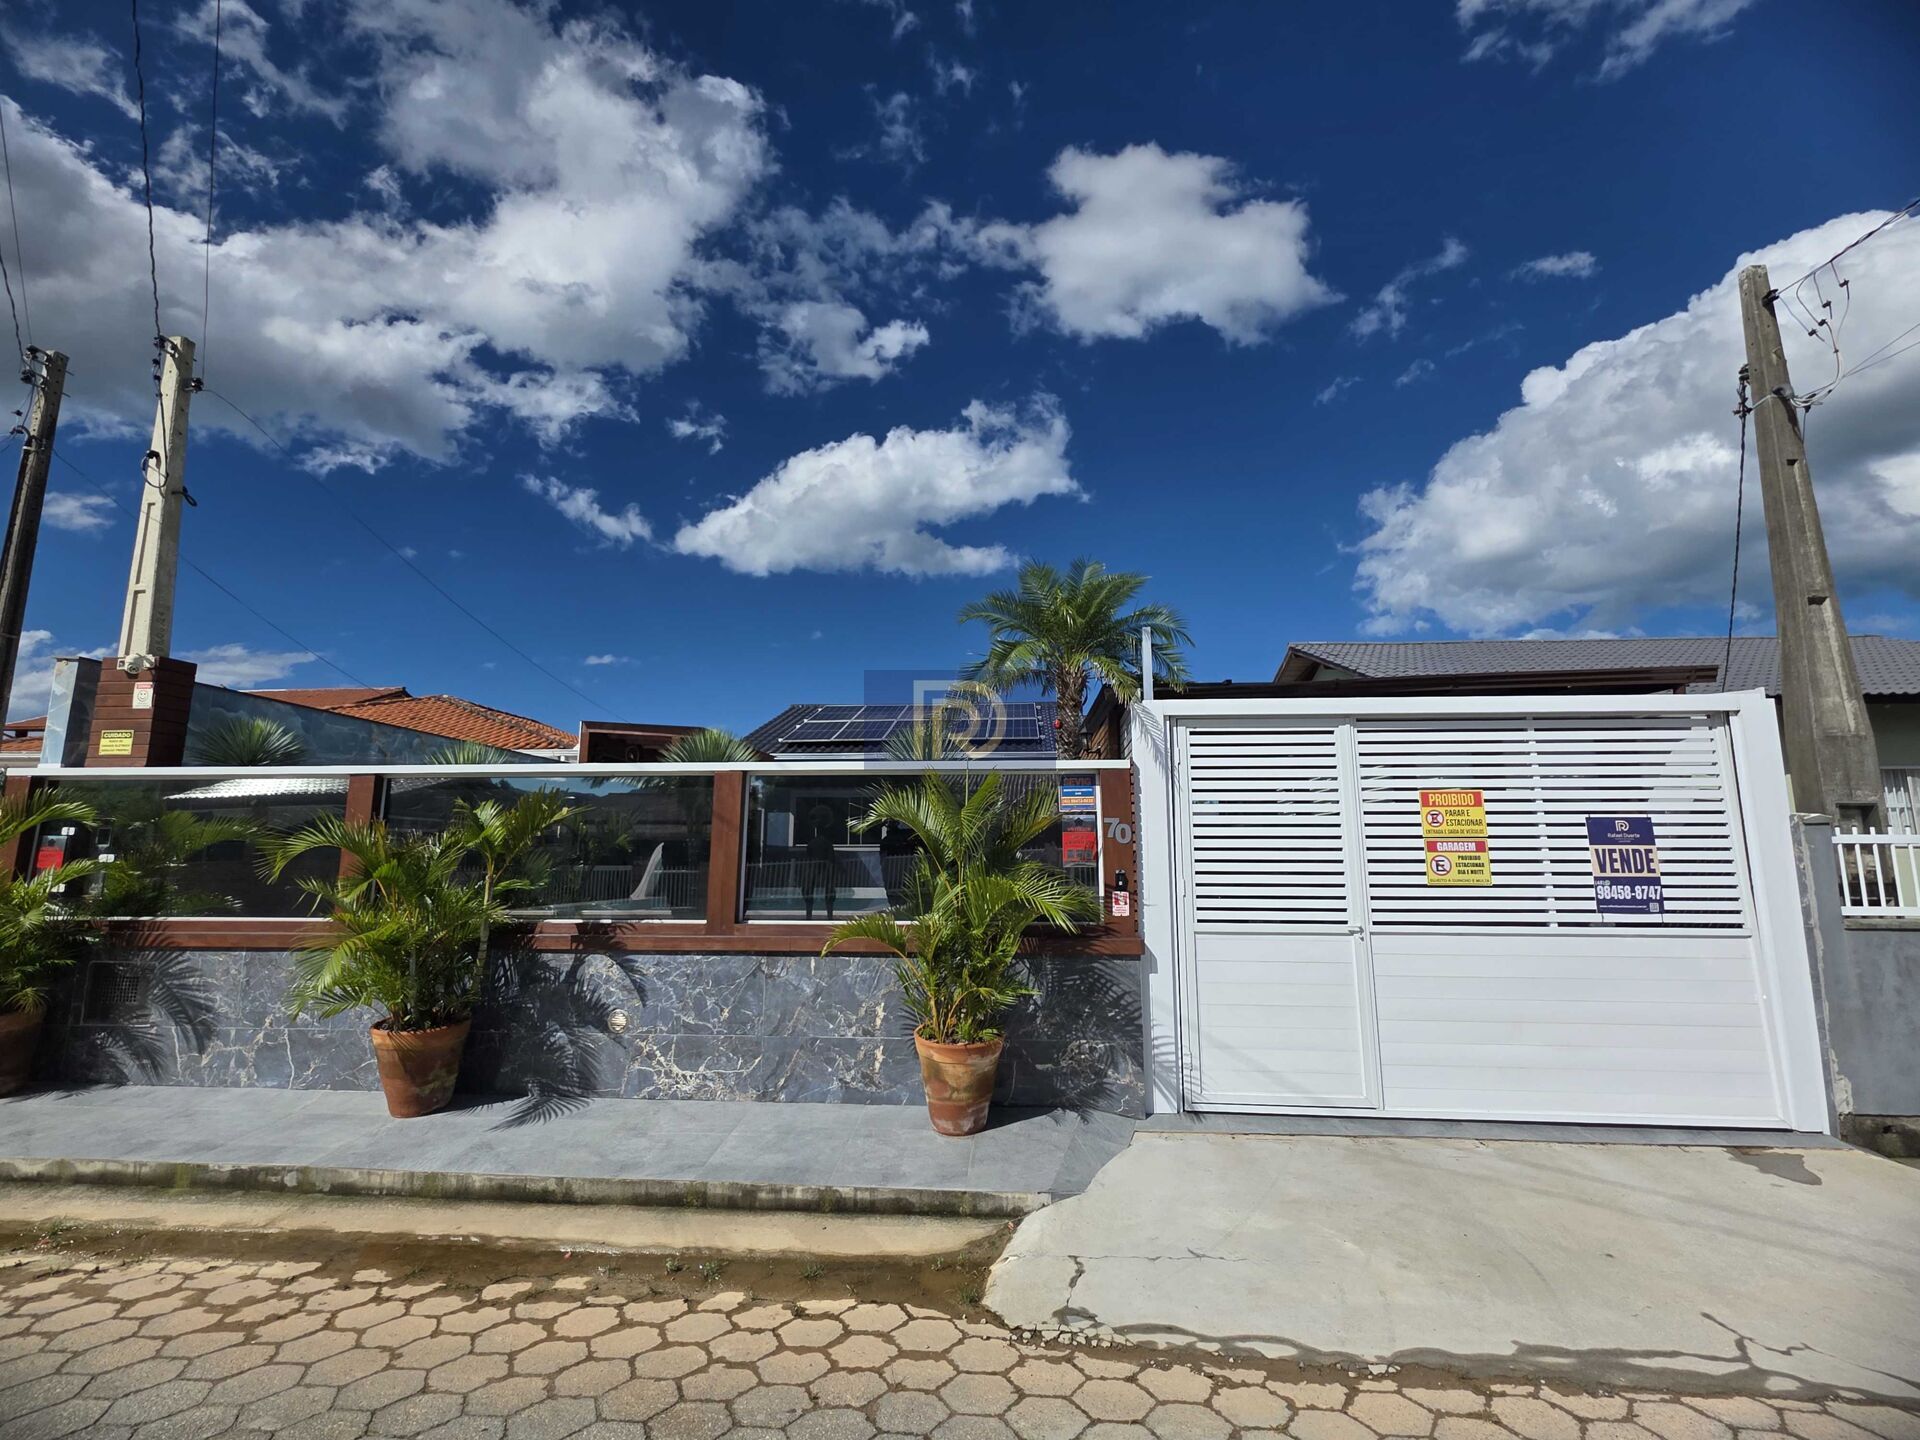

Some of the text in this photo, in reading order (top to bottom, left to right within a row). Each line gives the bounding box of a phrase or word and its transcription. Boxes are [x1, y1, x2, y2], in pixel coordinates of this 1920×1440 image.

[1428, 793, 1475, 806] PROIBIDO
[1103, 817, 1132, 844] 70
[1436, 842, 1476, 851] GARAGEM
[1594, 848, 1657, 874] VENDE
[1596, 885, 1661, 900] 98458-8747
